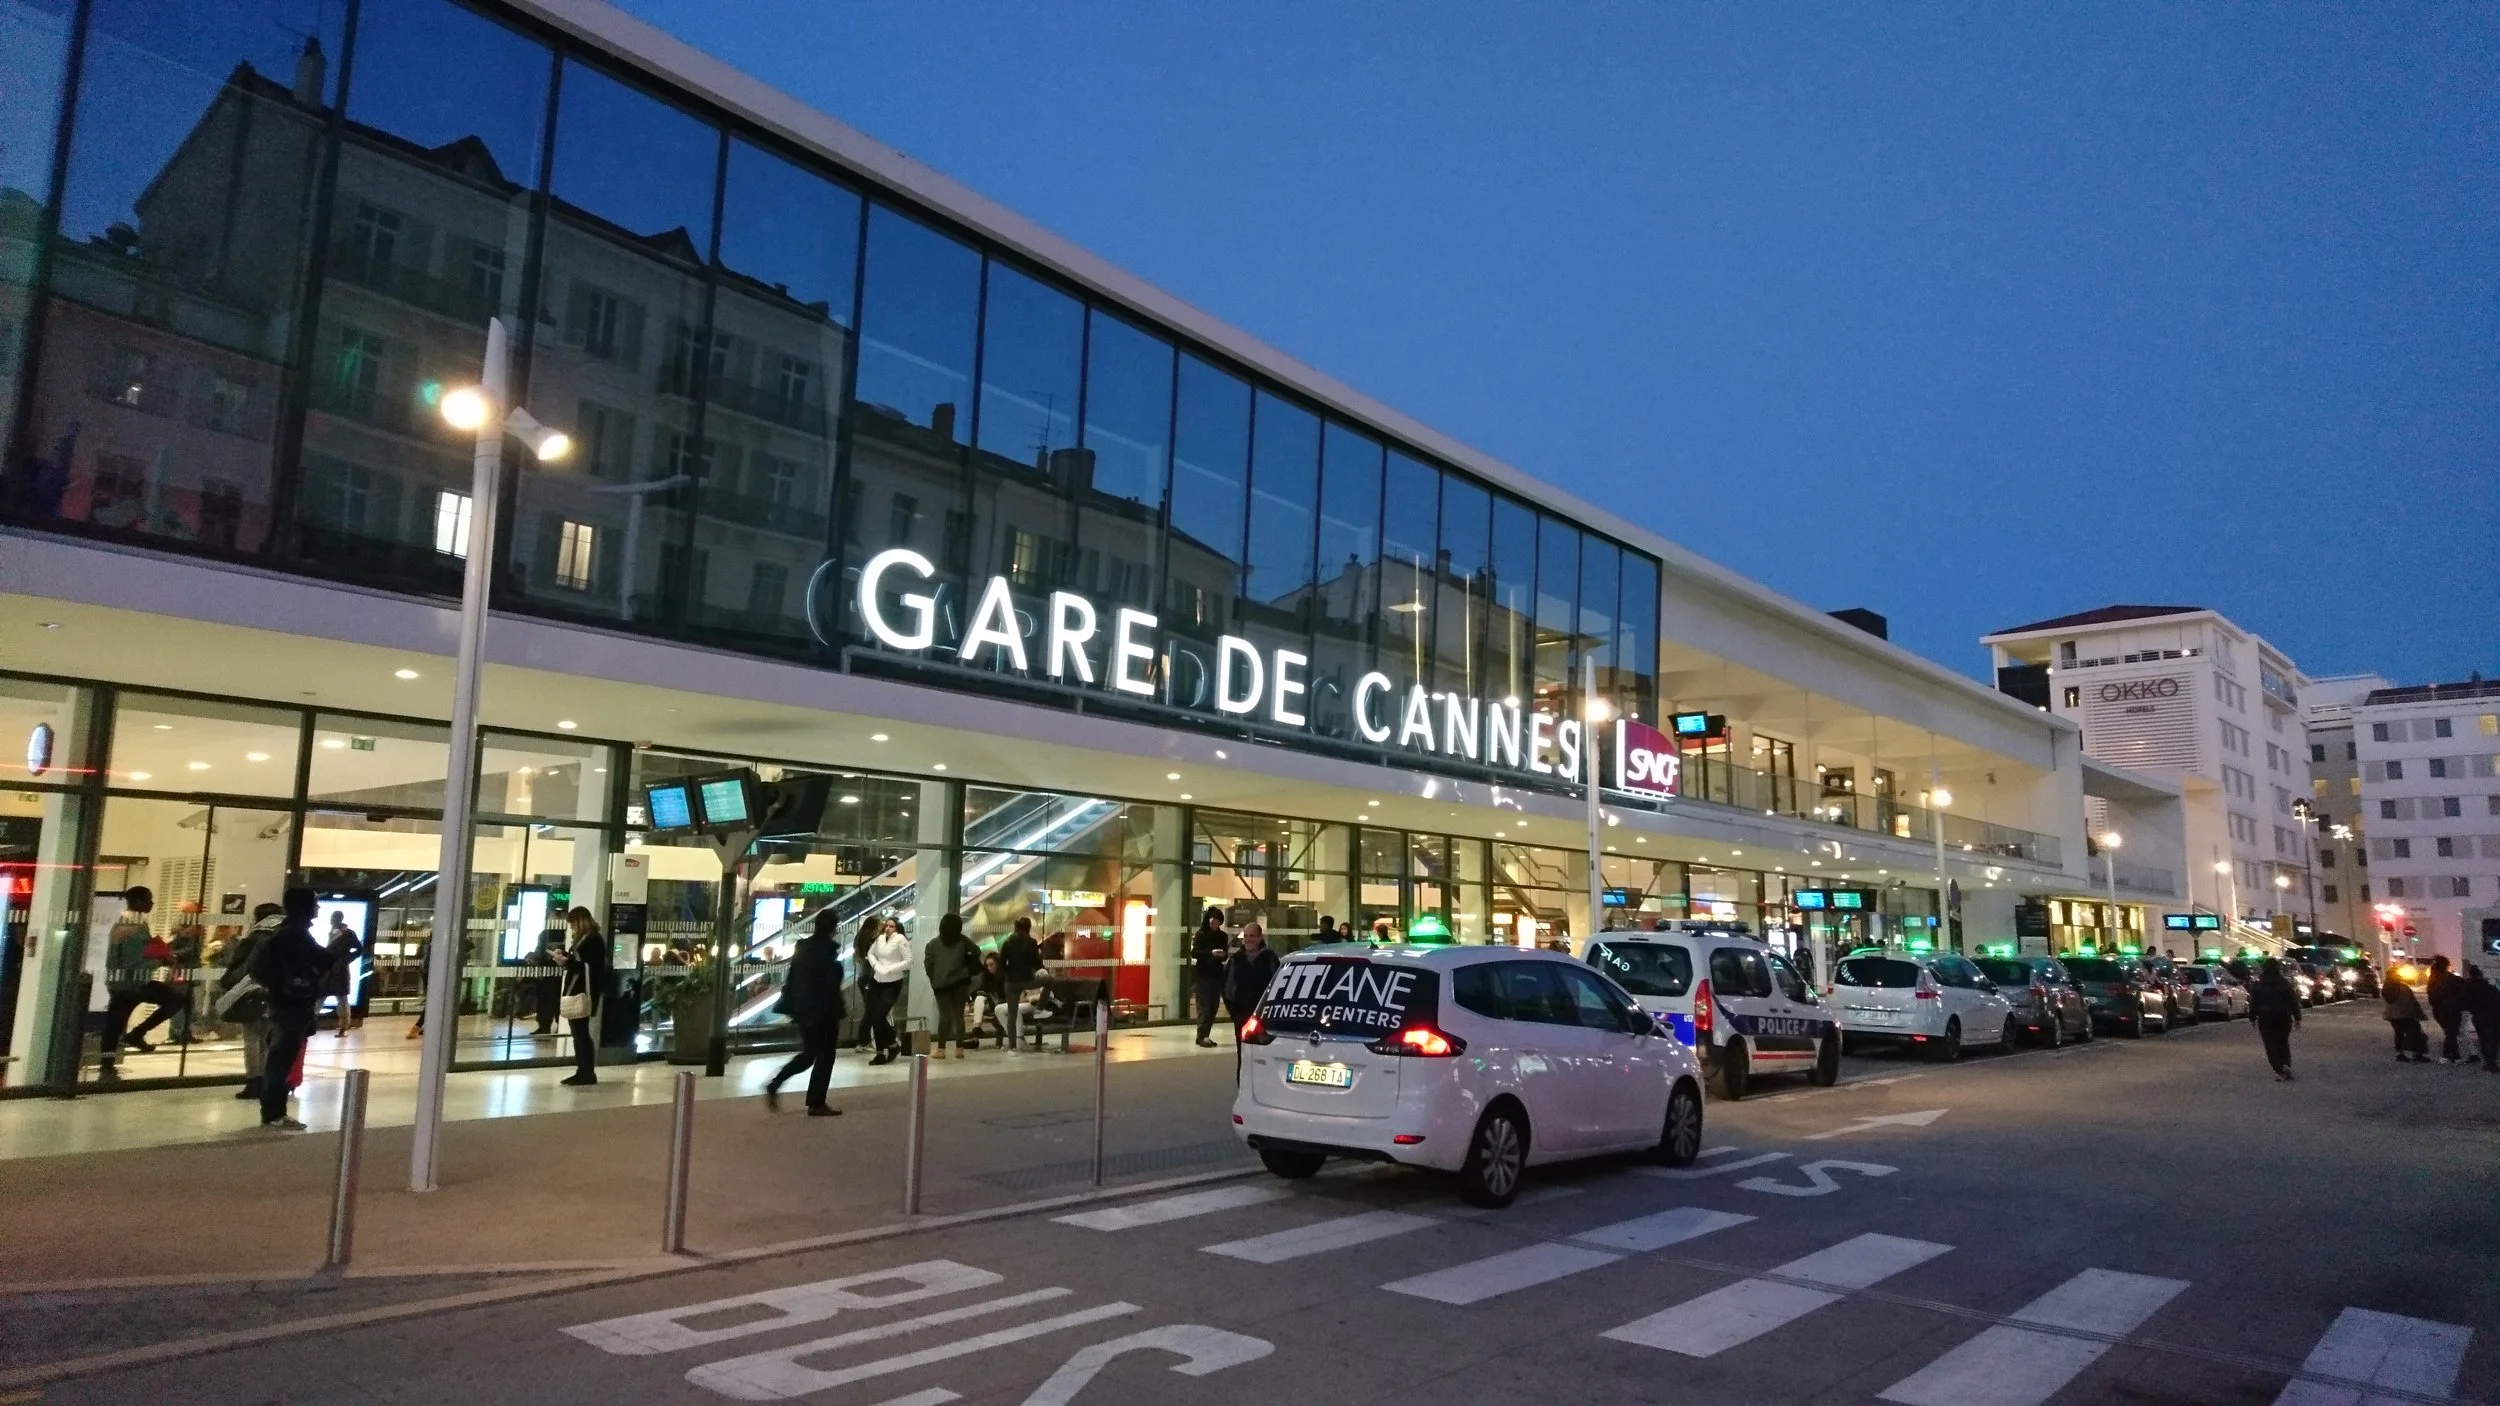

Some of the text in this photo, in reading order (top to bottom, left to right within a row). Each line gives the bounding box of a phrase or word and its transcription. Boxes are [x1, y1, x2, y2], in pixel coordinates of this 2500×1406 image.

[857, 548, 1580, 779] GARE DE CANNES
[2100, 678, 2179, 702] OKKO
[1626, 748, 1680, 786] SNCF
[1266, 964, 1417, 1011] FITLANE
[1261, 1003, 1402, 1029] FITNESS CENTERS
[1758, 1017, 1800, 1035] POLICE
